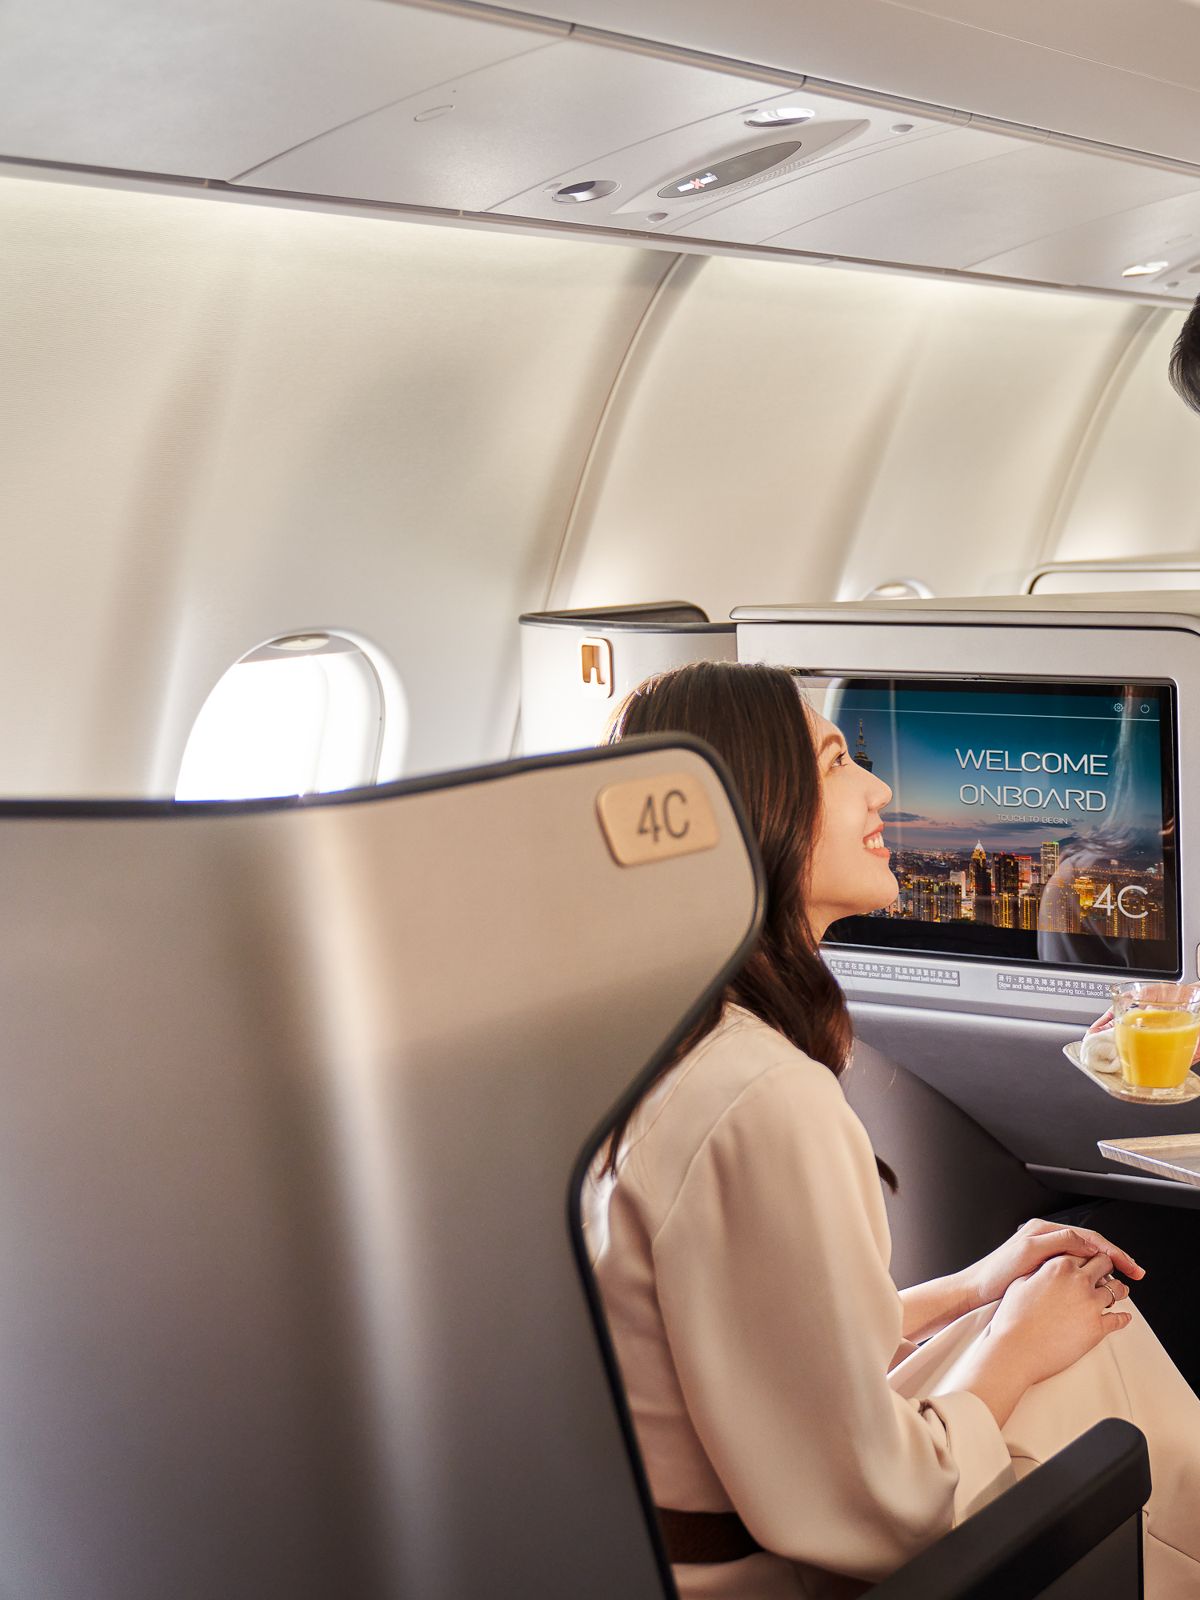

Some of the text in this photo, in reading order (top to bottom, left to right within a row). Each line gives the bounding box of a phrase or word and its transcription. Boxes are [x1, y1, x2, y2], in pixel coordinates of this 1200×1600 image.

[955, 748, 1109, 776] WELCOME
[959, 783, 1107, 812] ONBOARD
[637, 789, 691, 843] 4C
[995, 813, 1068, 824] TOUCH TO BEGIN
[1092, 883, 1149, 919] 4C
[1057, 987, 1074, 995] during
